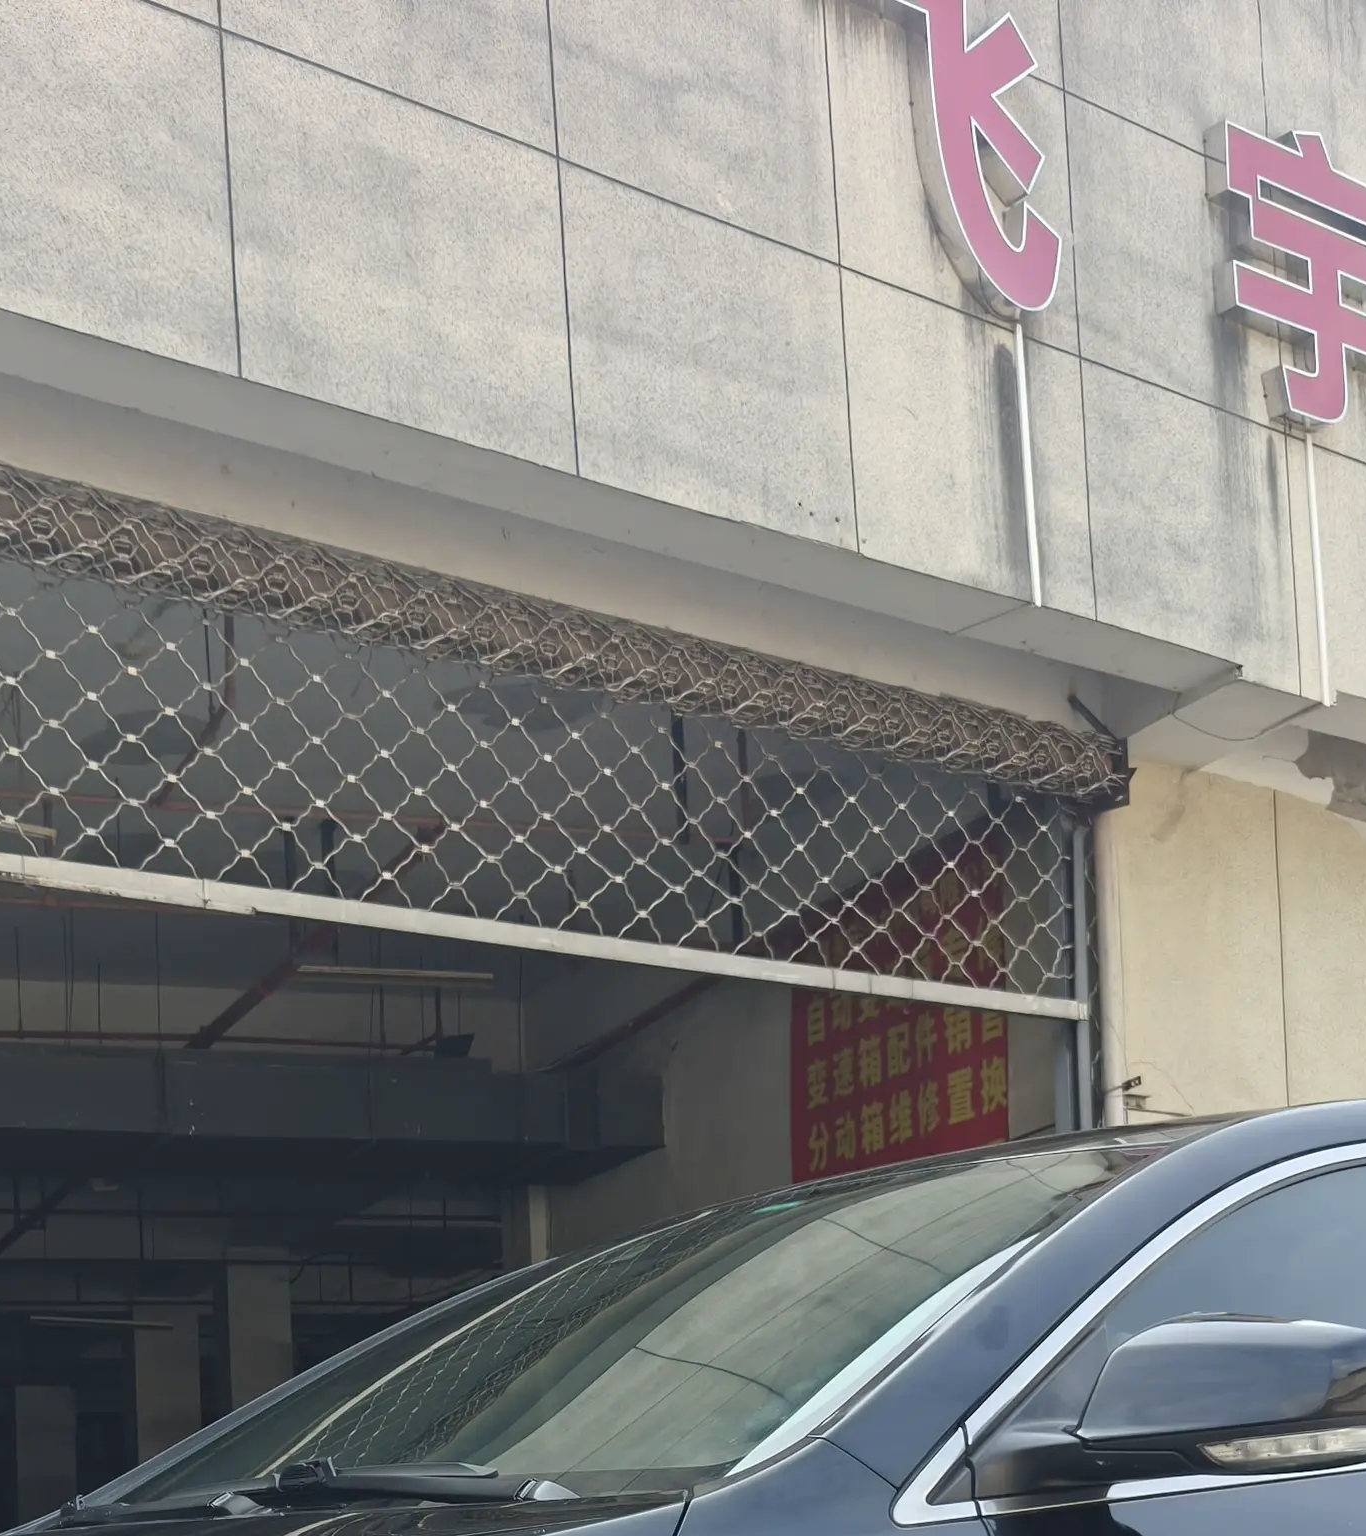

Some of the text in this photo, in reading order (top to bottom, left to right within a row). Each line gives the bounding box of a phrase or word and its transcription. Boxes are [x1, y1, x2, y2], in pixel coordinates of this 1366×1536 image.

[808, 1056, 1008, 1172] 分动箱维修置换
